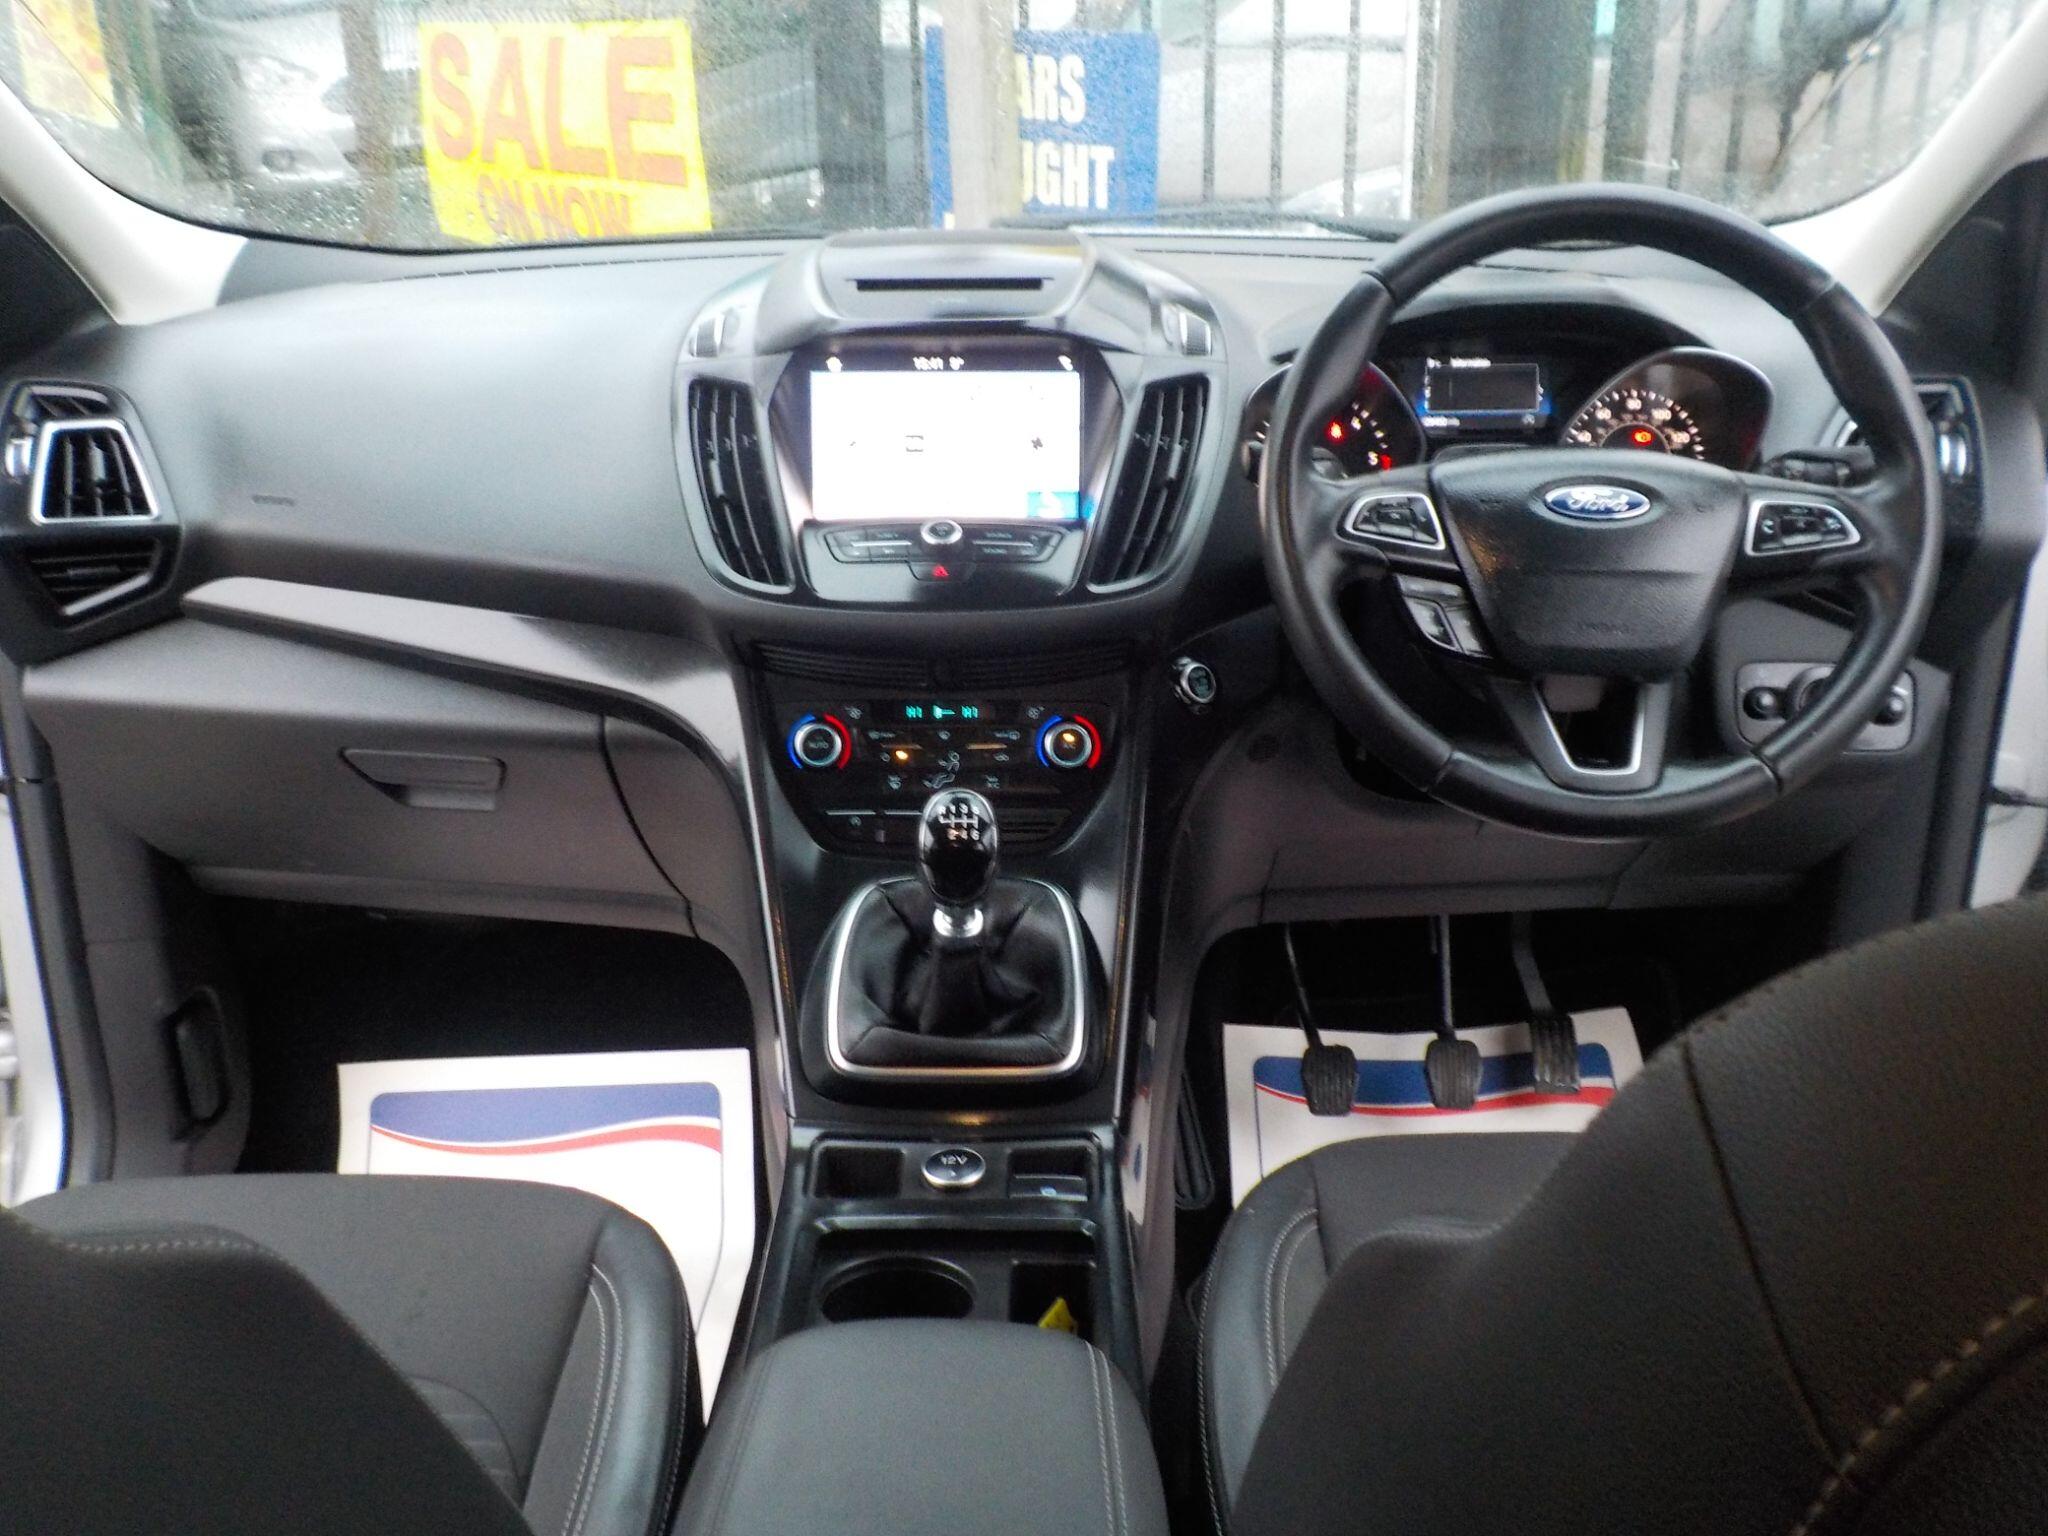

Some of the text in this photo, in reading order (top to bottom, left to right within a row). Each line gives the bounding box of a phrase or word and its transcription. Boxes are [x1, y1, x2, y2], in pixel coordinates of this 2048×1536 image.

[430, 31, 689, 188] SALE
[1013, 53, 1088, 125] ARS
[478, 173, 631, 242] ON NOW
[1567, 487, 1630, 512] Ford
[940, 1153, 968, 1166] 12V
